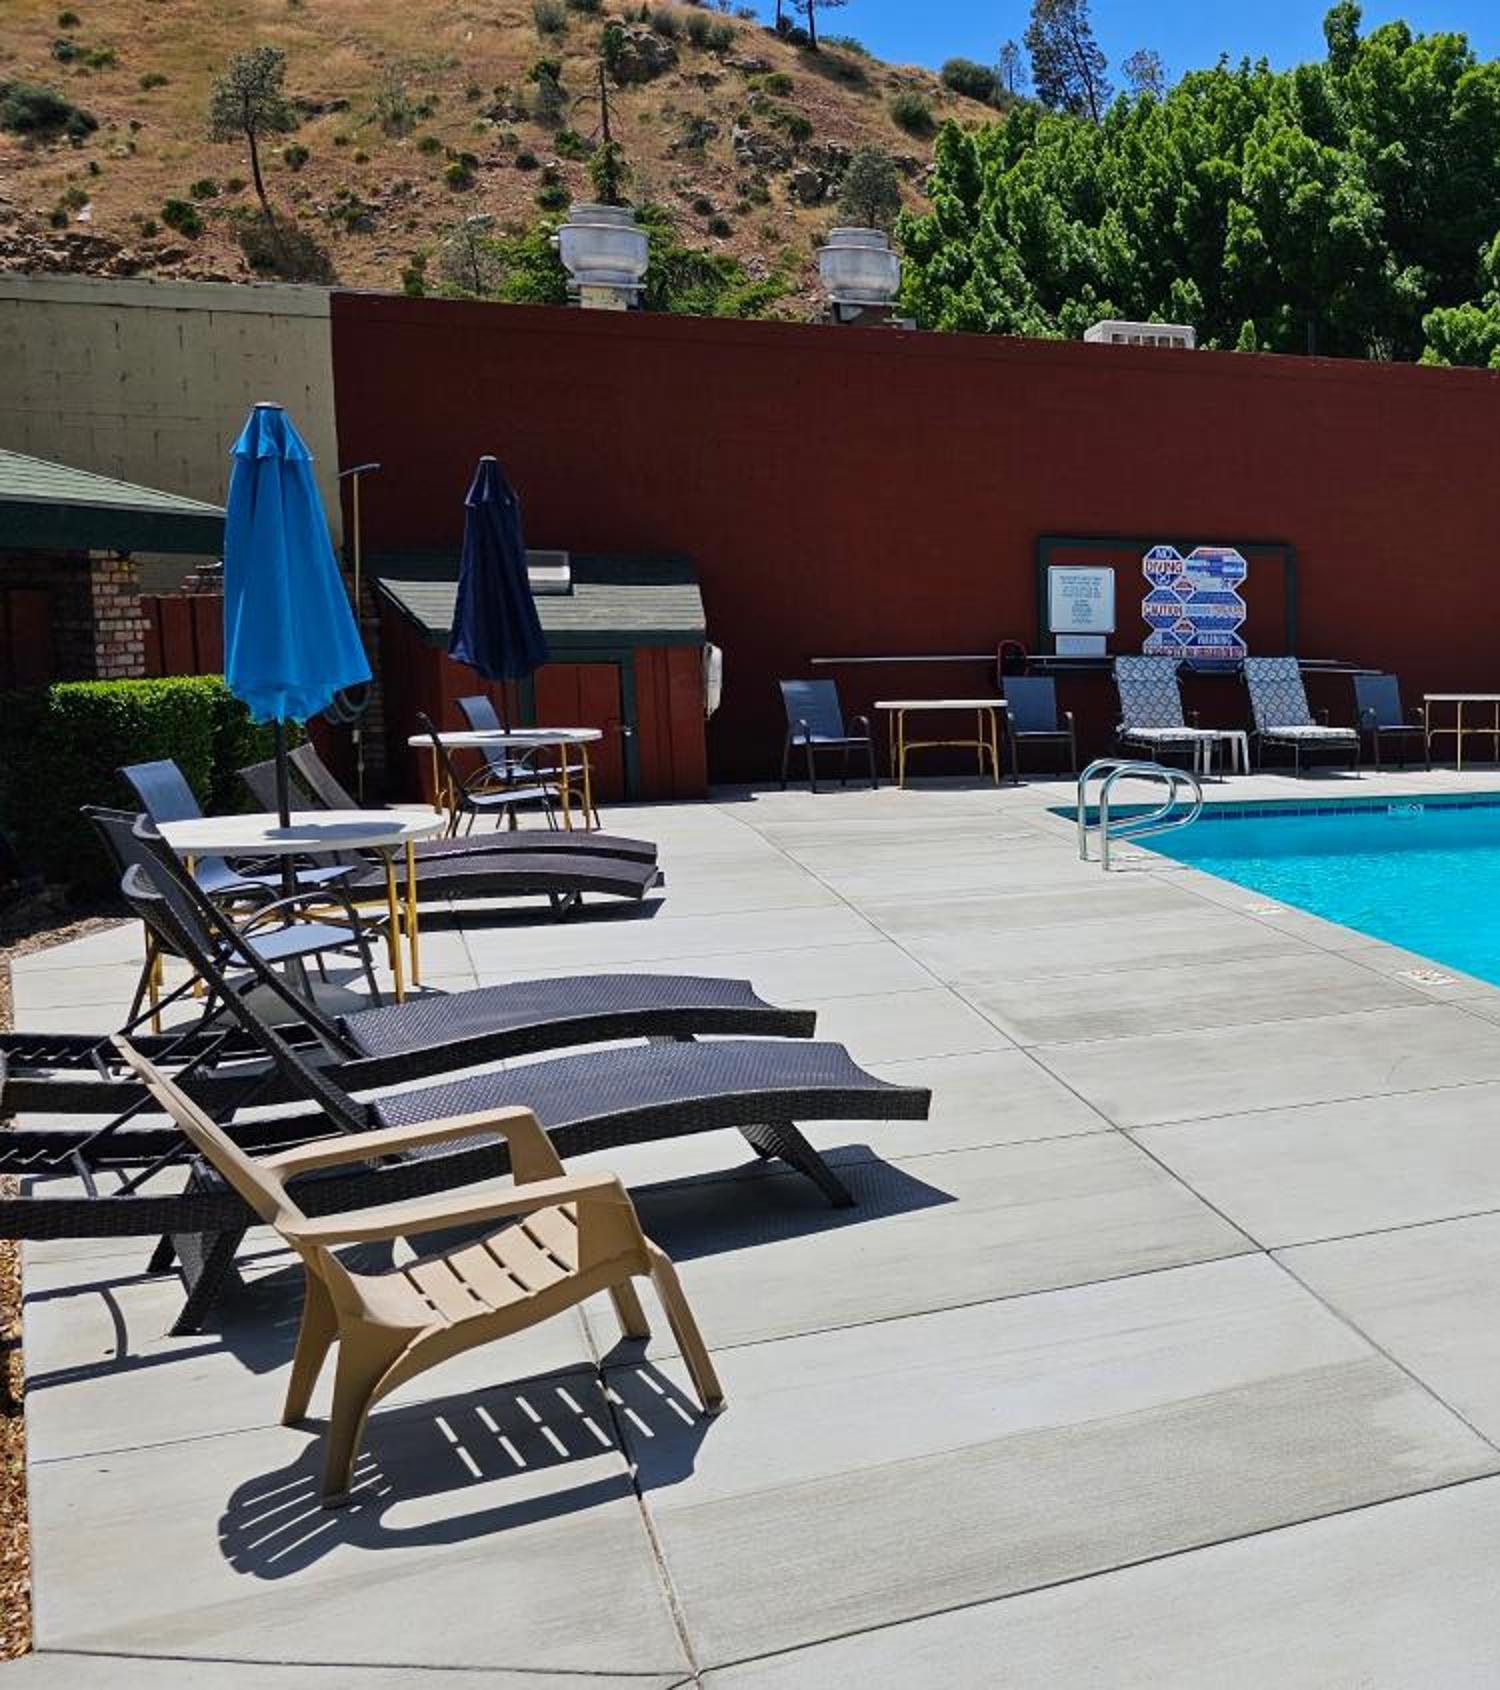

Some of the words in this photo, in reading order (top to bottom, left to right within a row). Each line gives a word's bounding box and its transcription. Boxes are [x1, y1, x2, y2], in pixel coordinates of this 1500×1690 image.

[1155, 549, 1173, 559] NO
[1145, 560, 1183, 573] DIVING
[1144, 604, 1183, 616] CAUTION
